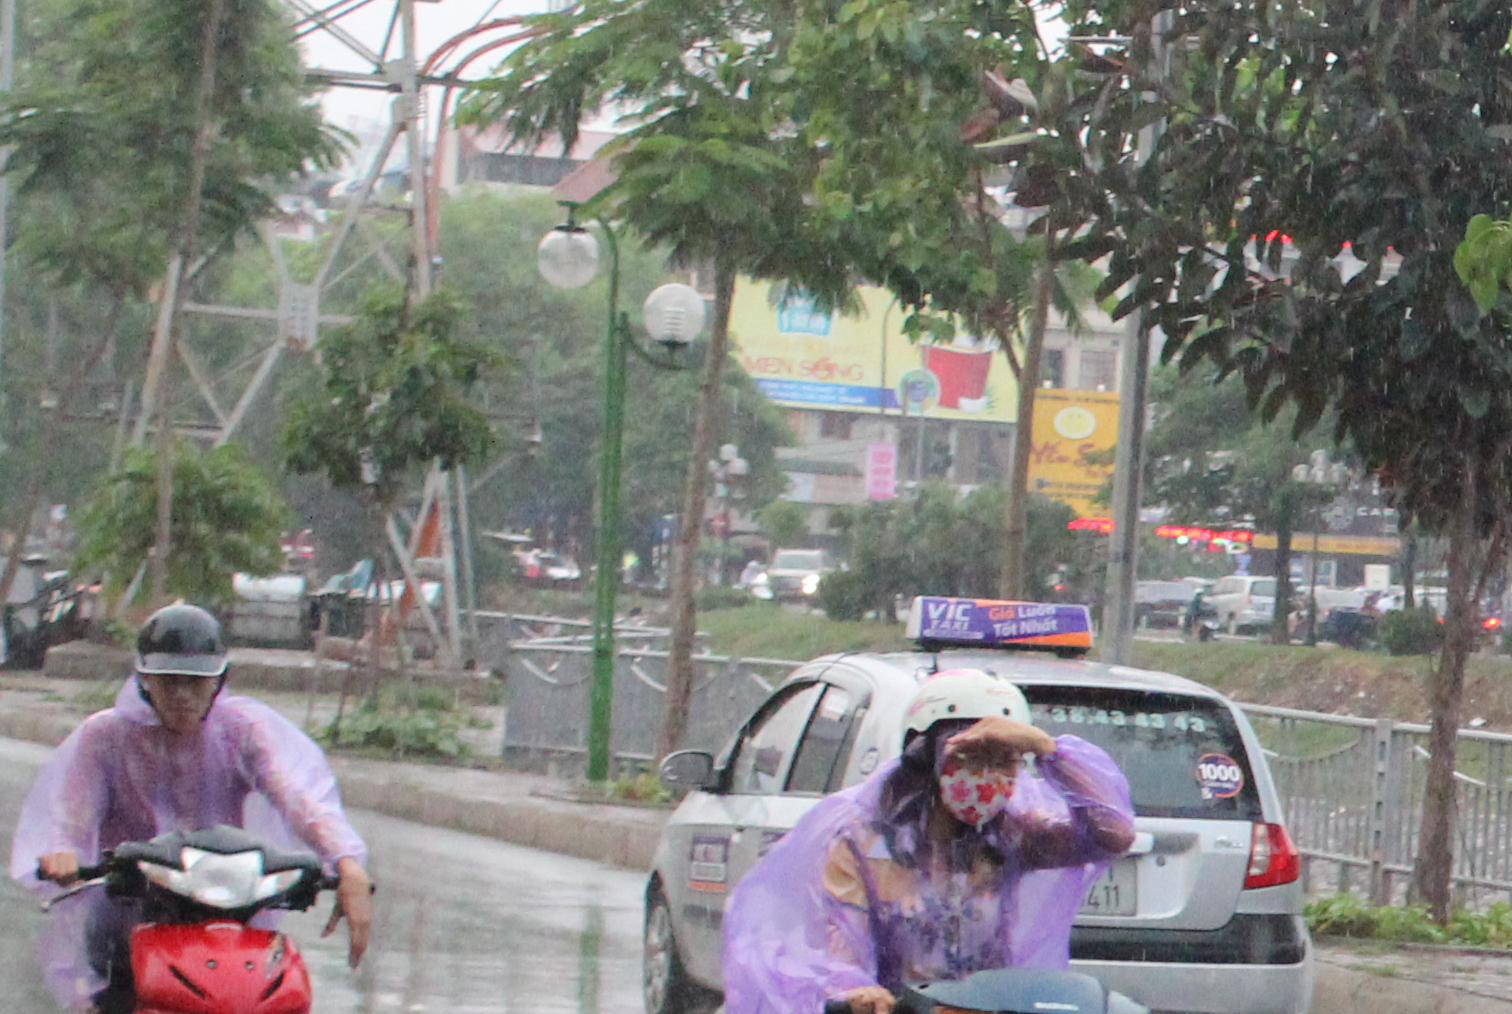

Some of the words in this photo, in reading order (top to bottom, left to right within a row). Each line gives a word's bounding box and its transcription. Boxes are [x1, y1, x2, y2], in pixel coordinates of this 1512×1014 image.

[928, 602, 972, 621] VIC
[930, 620, 969, 630] TAXI
[1197, 763, 1240, 782] 1000
[1080, 885, 1119, 908] 411
